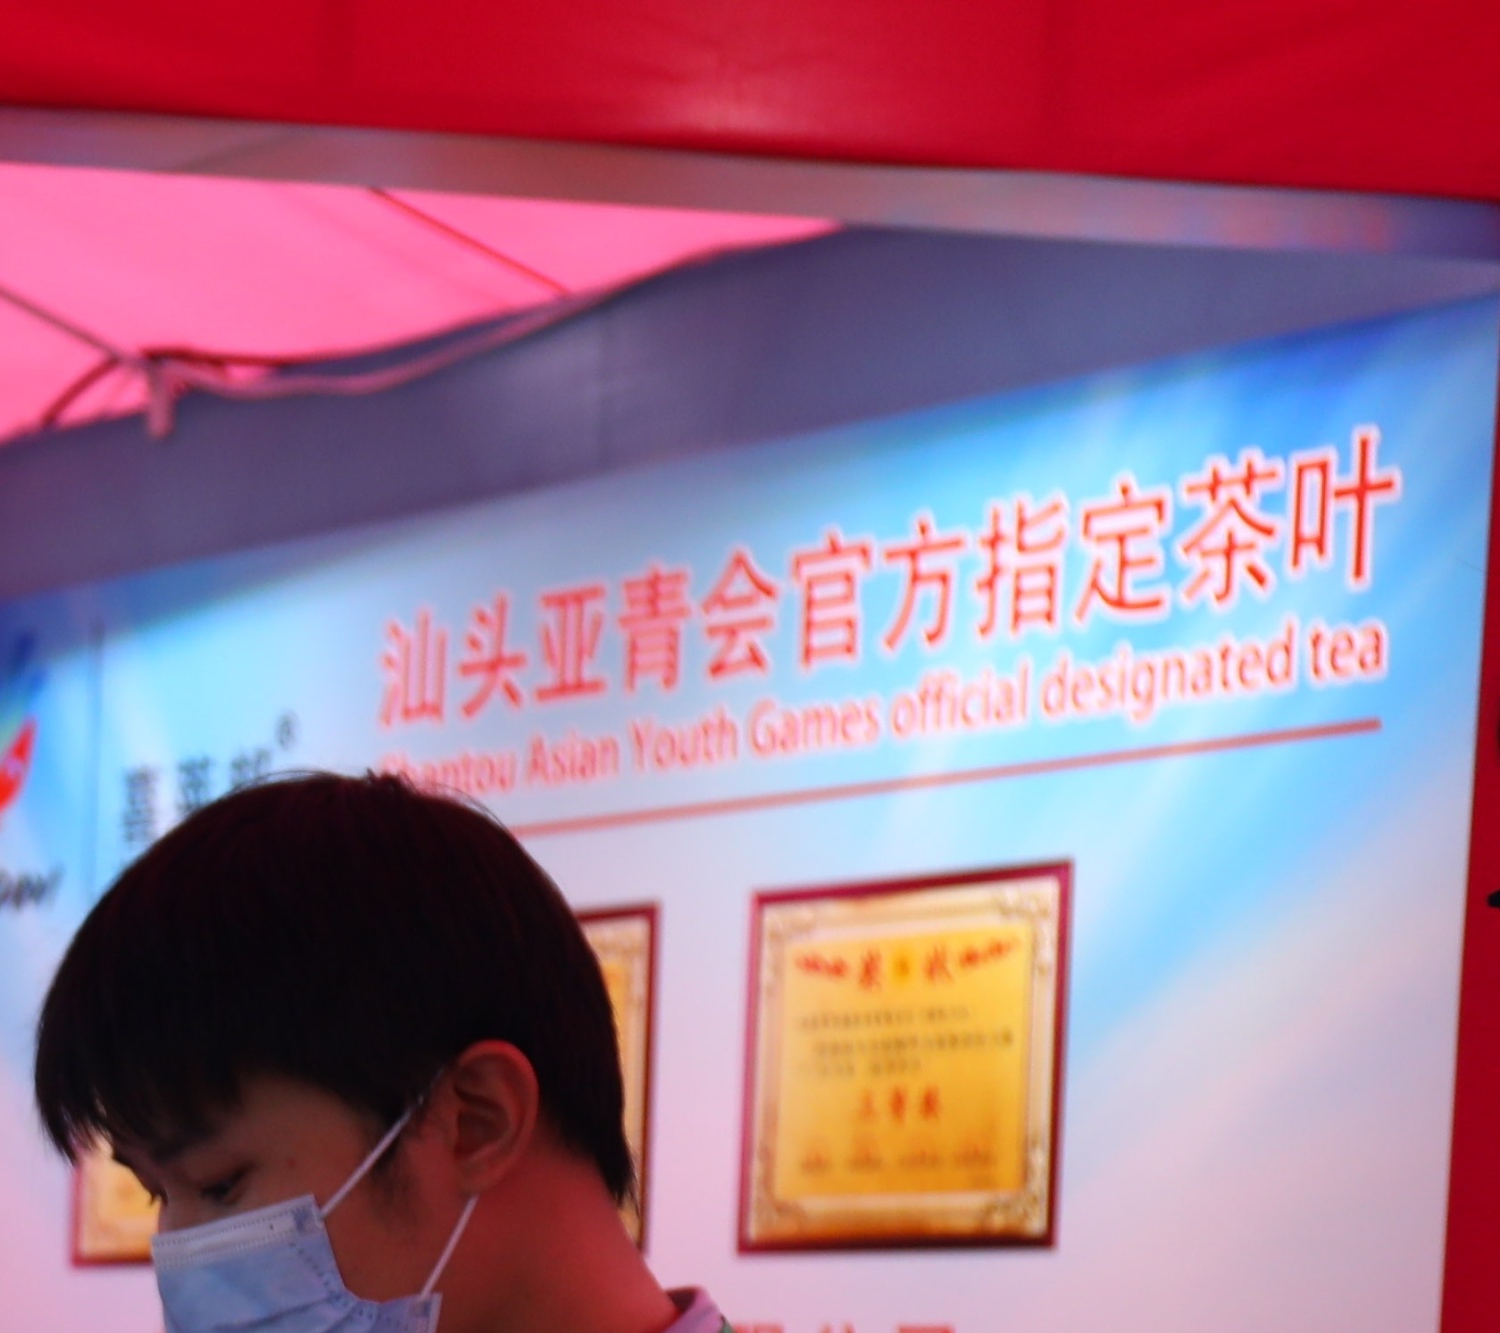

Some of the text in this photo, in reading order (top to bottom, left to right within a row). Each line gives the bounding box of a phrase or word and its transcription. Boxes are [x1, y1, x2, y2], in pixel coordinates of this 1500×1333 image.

[379, 425, 1402, 728] 汕头亚青会官方指定茶叶
[527, 727, 621, 788] Asian
[629, 707, 739, 771] Youth
[748, 697, 880, 757] Games
[890, 659, 1032, 740] official
[1041, 619, 1296, 728] designated
[1307, 619, 1387, 678] tea
